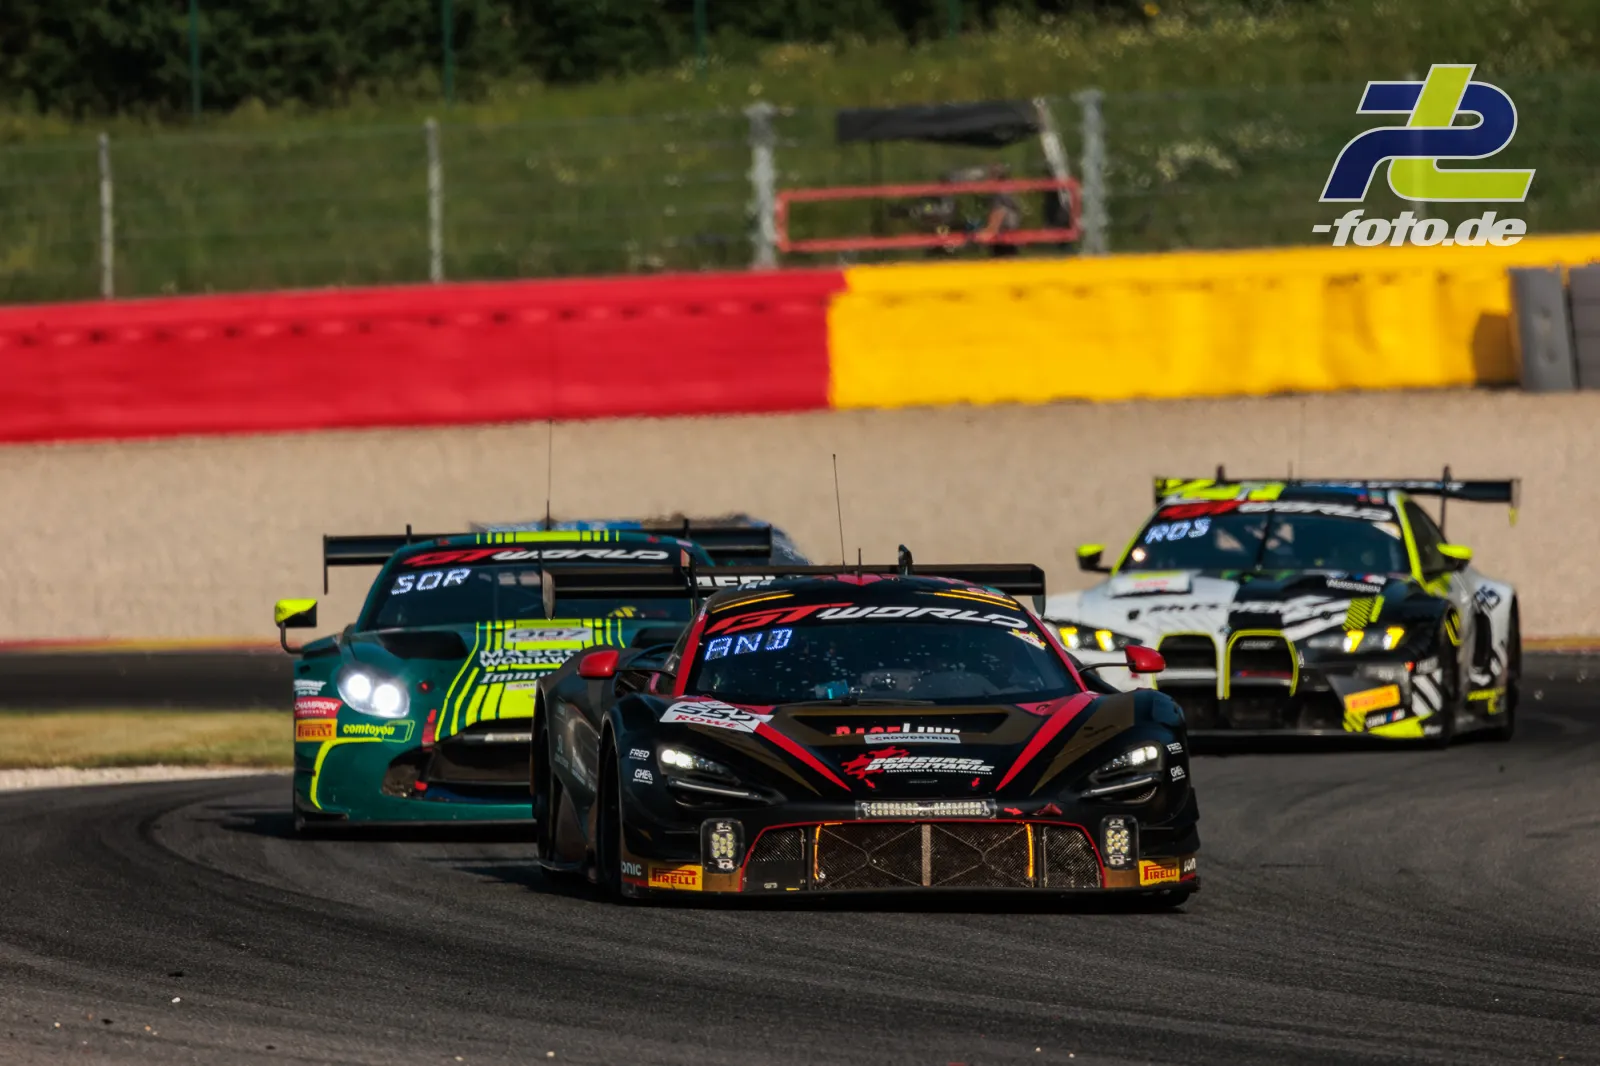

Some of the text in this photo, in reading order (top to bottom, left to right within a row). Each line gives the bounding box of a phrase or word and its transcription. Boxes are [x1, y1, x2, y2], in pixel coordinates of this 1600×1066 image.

[391, 568, 471, 595] SOR
[704, 628, 793, 661] AND
[674, 714, 740, 729] ROWE
[343, 723, 395, 737] comtoyou
[630, 748, 650, 758] FRED
[652, 868, 697, 885] PIRELLI
[1144, 864, 1177, 880] PIRELLI
